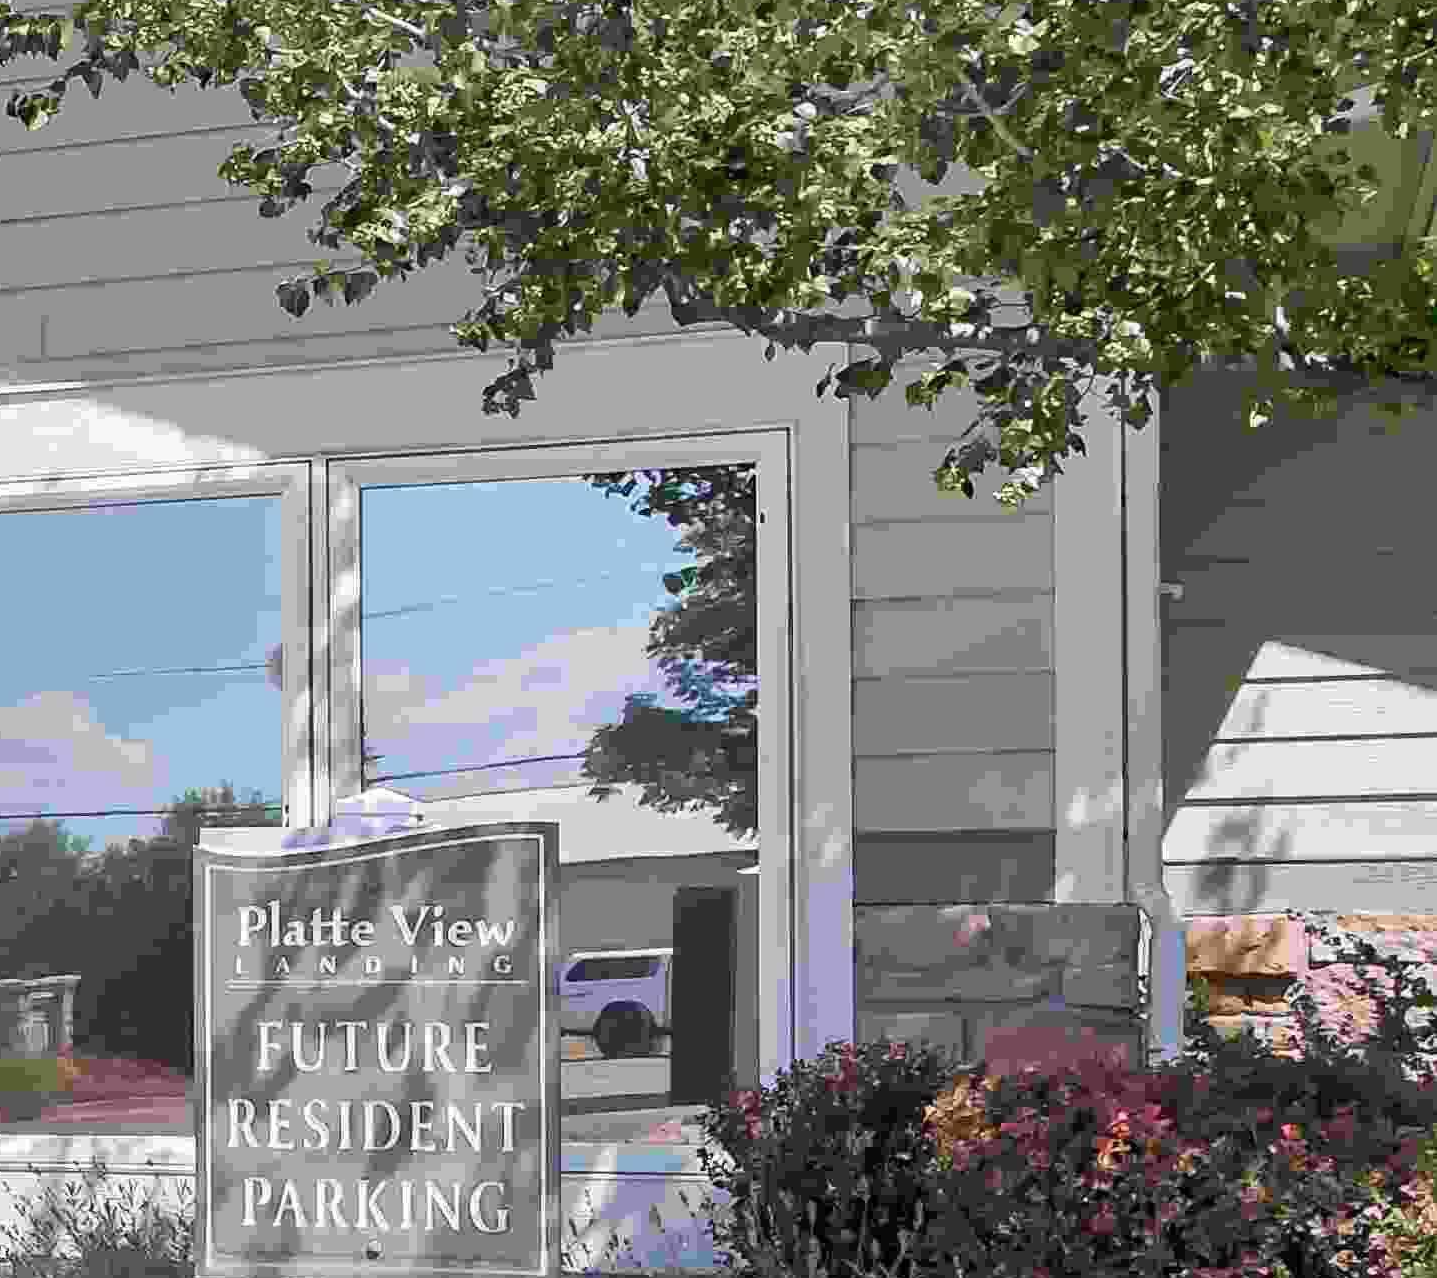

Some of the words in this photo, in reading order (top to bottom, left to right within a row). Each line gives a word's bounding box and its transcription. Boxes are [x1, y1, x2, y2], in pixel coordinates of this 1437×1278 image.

[235, 899, 378, 949] Platte
[389, 903, 515, 949] View
[234, 954, 515, 976] LANDING
[255, 1022, 495, 1075] FUTURE
[226, 1098, 527, 1155] RESIDENT
[240, 1176, 515, 1235] PARKING
